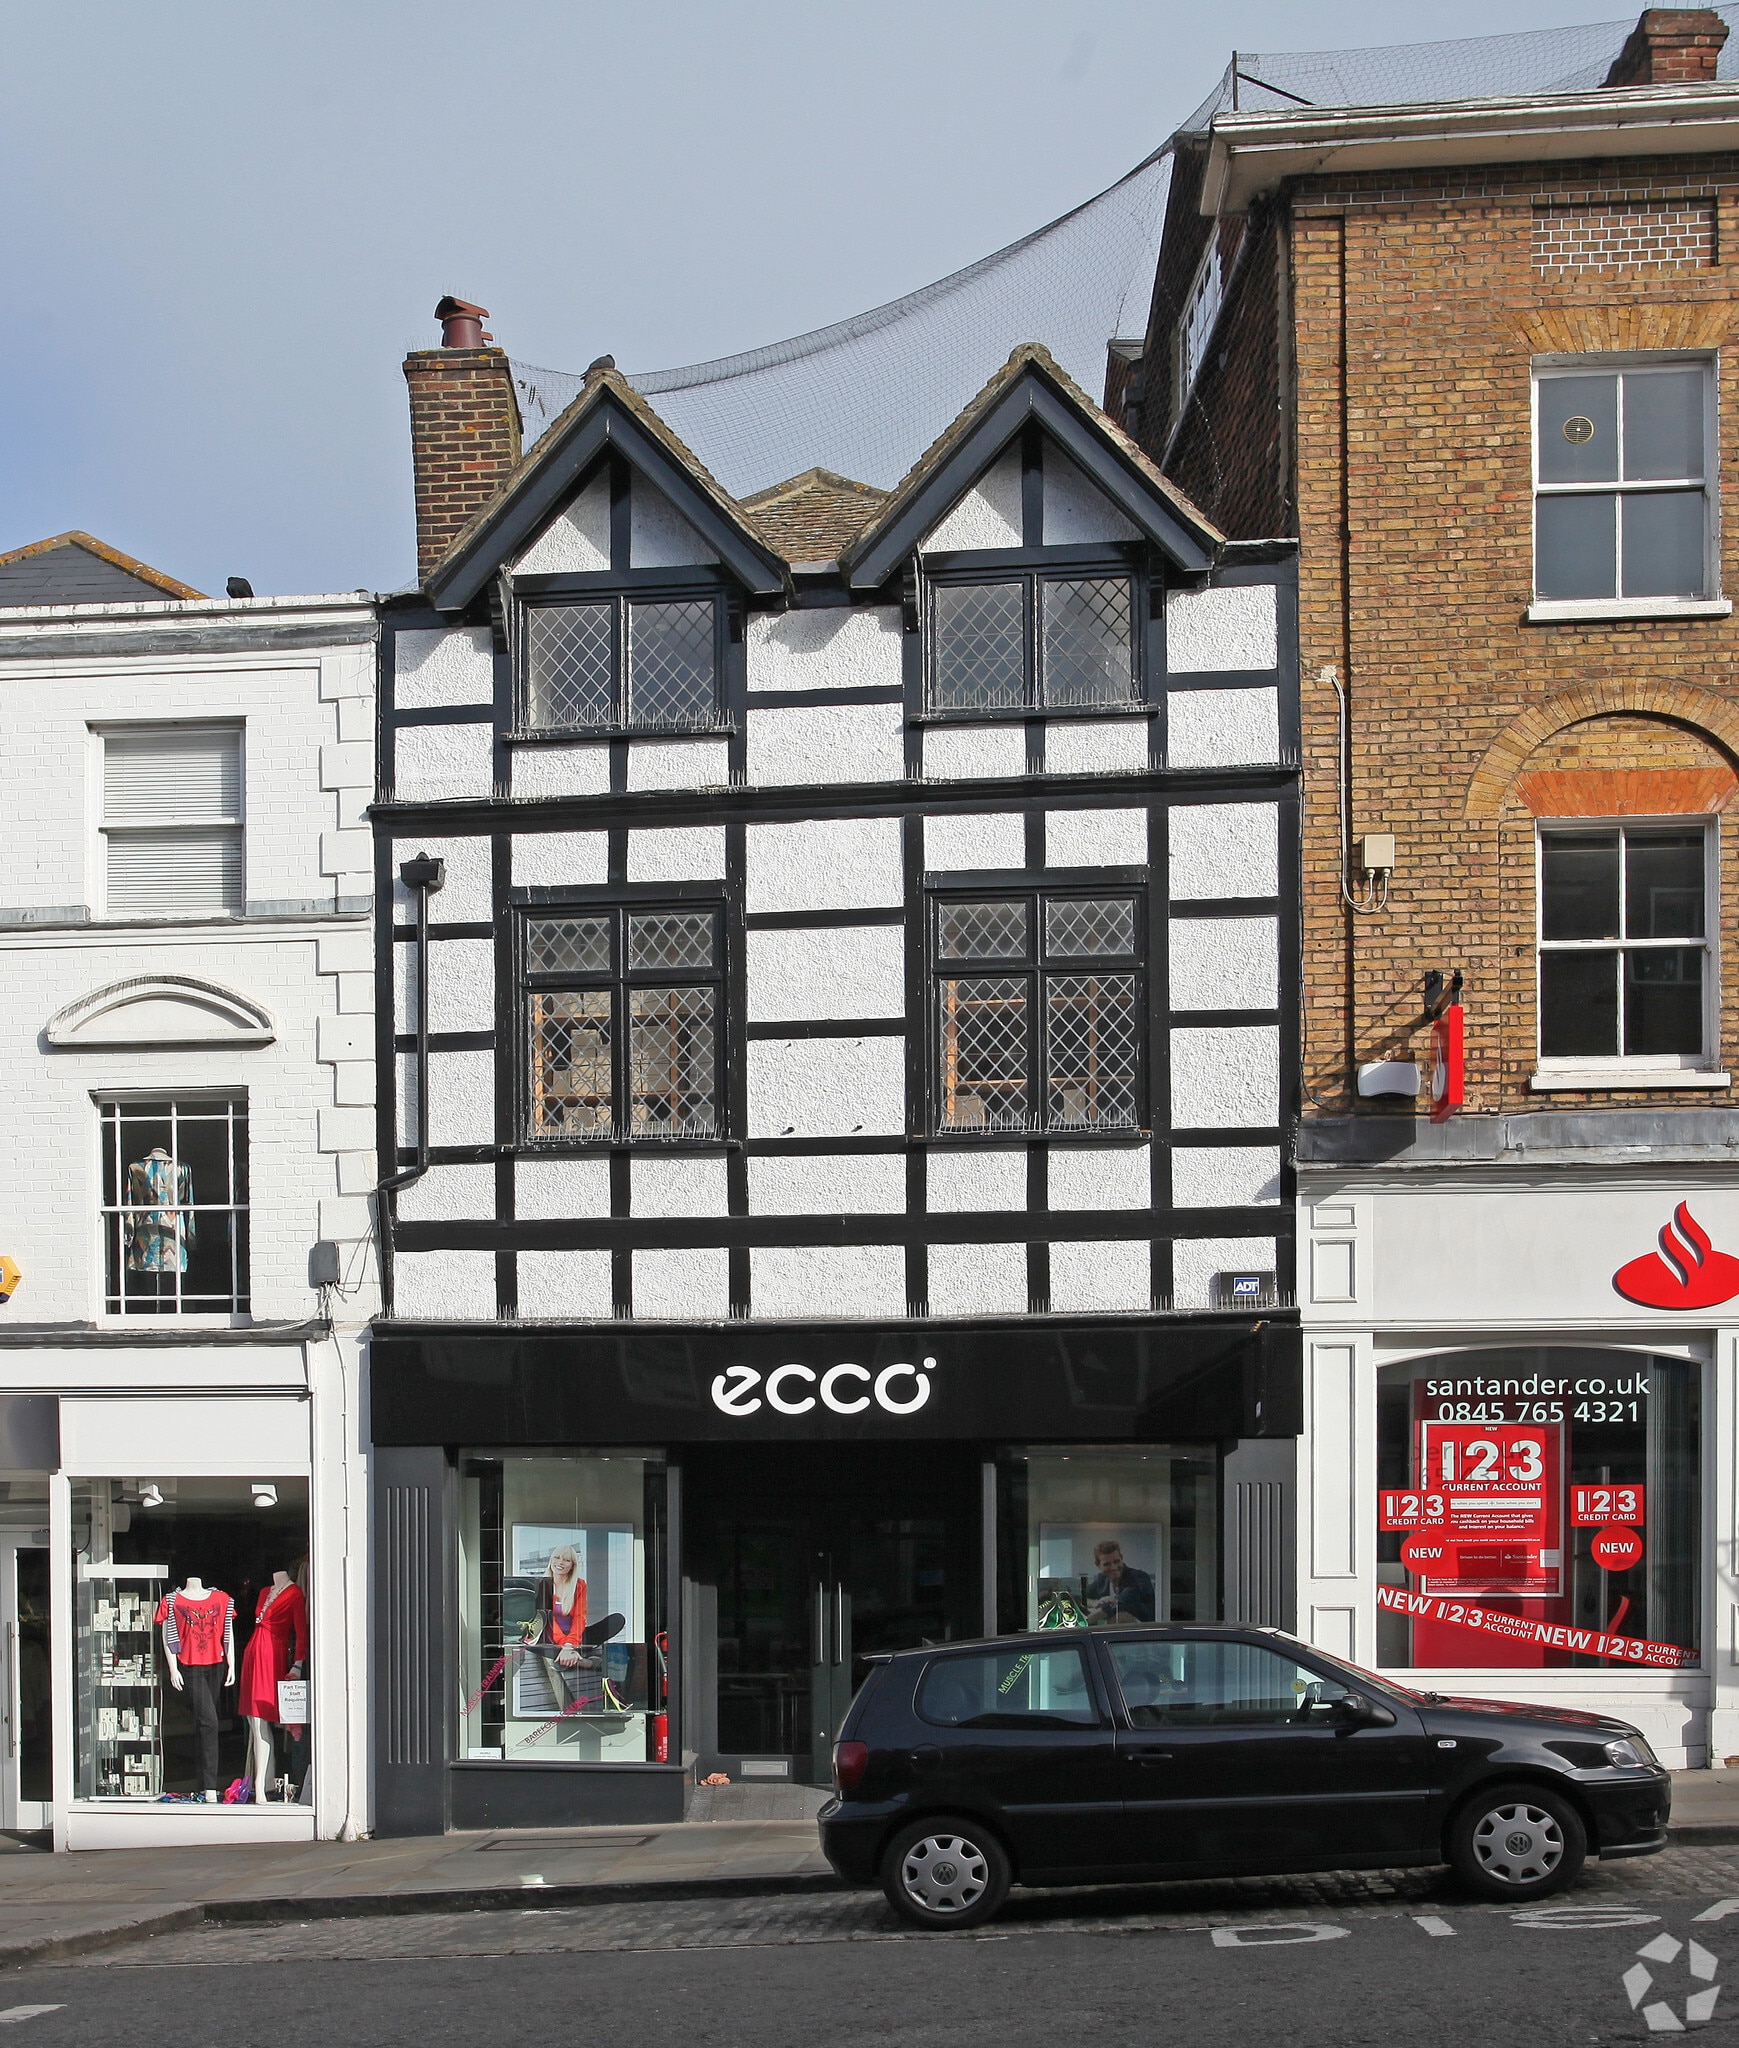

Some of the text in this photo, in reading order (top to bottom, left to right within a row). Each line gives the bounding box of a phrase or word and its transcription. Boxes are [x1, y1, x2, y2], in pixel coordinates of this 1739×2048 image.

[1235, 1281, 1258, 1292] ADT
[711, 1363, 931, 1416] ecco
[1426, 1372, 1651, 1396] santander.co.uk
[1438, 1401, 1638, 1423] 0845 765 4321
[1442, 1483, 1542, 1491] CURRENT ACCOUNT
[1386, 1518, 1418, 1526] CREDIT
[1578, 1513, 1609, 1521] CREDIT
[1409, 1547, 1443, 1559] NEW
[1600, 1542, 1634, 1553] NEW
[1378, 1588, 1432, 1614] NEW
[1483, 1622, 1533, 1640] ACCOUNT
[1486, 1613, 1536, 1631] CURRENT
[1534, 1624, 1592, 1650] NEW
[1647, 1644, 1698, 1659] CURRENT
[998, 1663, 1022, 1694] MUSCLE
